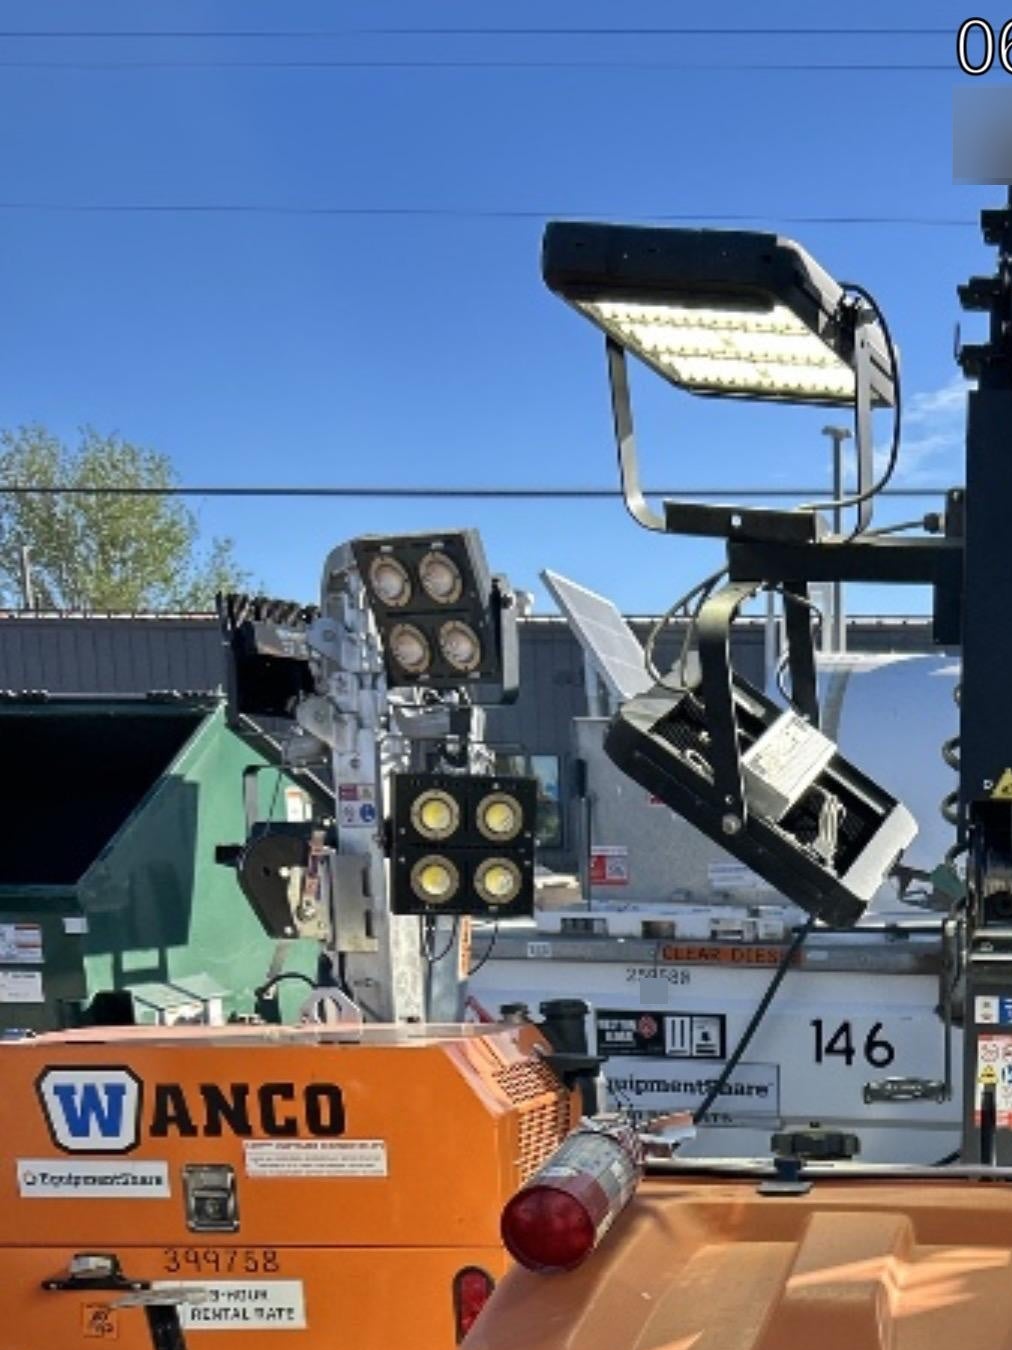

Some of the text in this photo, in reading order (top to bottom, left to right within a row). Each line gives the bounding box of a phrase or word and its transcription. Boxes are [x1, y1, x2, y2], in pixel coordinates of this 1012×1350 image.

[662, 945, 720, 962] CLEAR
[810, 1018, 896, 1068] 146
[53, 1082, 346, 1137] WANCO
[164, 1249, 280, 1273] 399758
[191, 1307, 250, 1321] RENTAL
